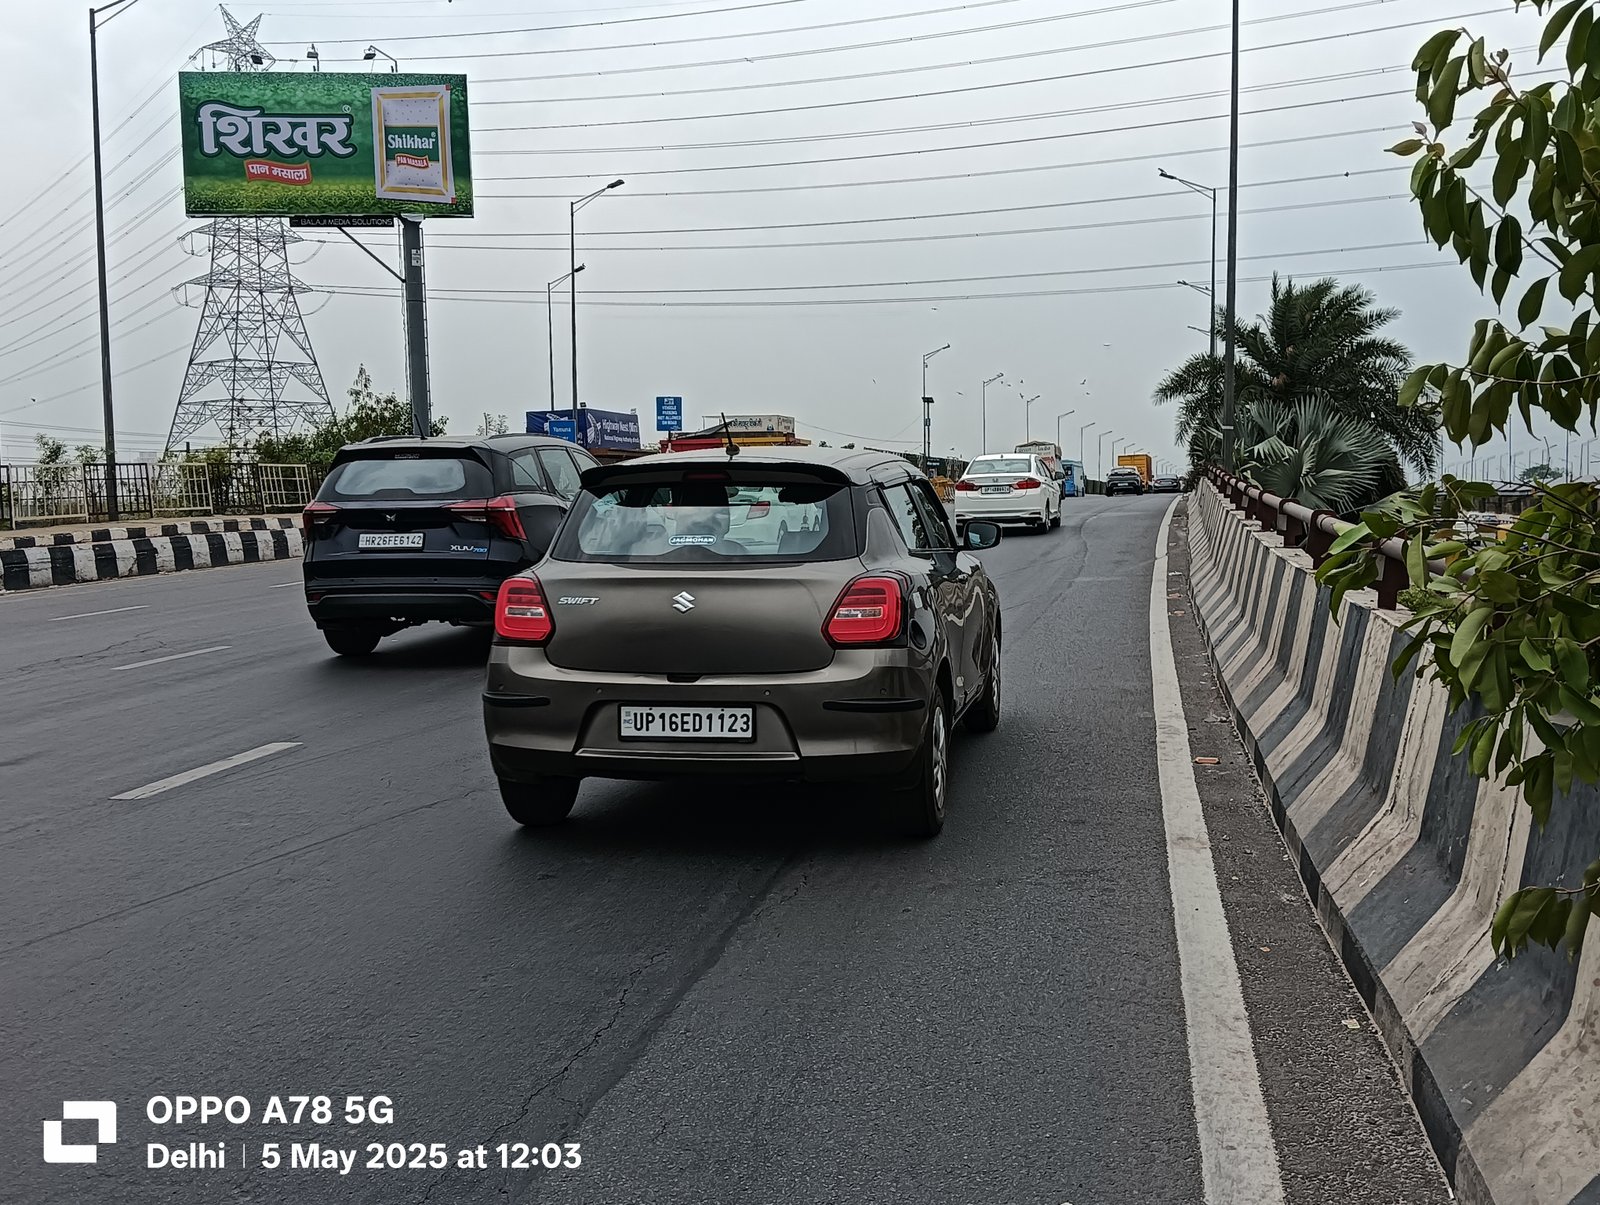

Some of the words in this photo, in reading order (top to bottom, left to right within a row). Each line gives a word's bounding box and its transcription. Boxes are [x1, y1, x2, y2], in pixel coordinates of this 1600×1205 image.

[197, 102, 354, 156] शिखर
[387, 133, 435, 149] Shikhar
[248, 162, 269, 176] पान
[271, 165, 308, 181] मसाला
[300, 218, 327, 226] BALAJI
[328, 218, 350, 226] MEDIA
[351, 218, 393, 226] SOLUTIONS
[365, 535, 422, 546] HR26FE6142
[558, 596, 599, 605] SWIFT
[633, 712, 751, 733] UP16ED1123
